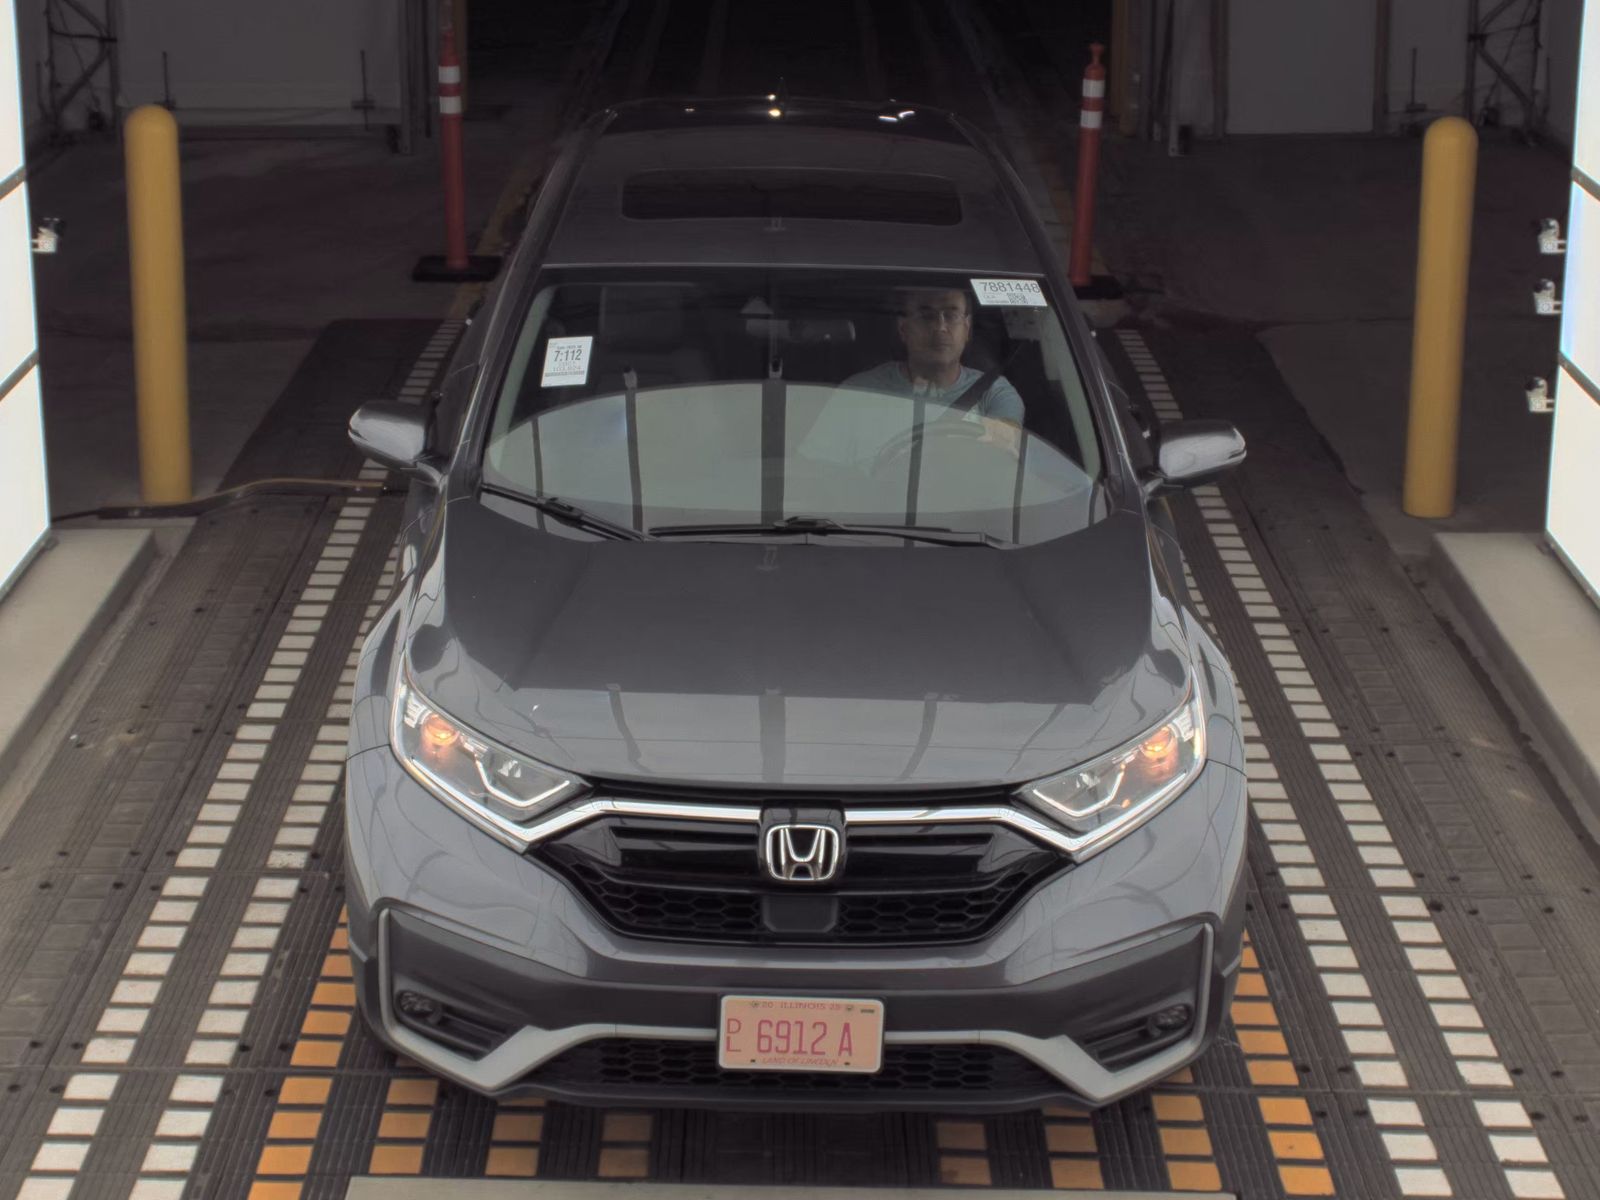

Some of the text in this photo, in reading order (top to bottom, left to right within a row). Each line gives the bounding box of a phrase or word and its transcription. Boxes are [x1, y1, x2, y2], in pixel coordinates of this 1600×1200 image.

[978, 281, 1041, 294] 7881448
[554, 349, 582, 362] 7:112
[780, 1001, 826, 1010] ILLINOIS
[757, 1019, 853, 1057] 6912 A
